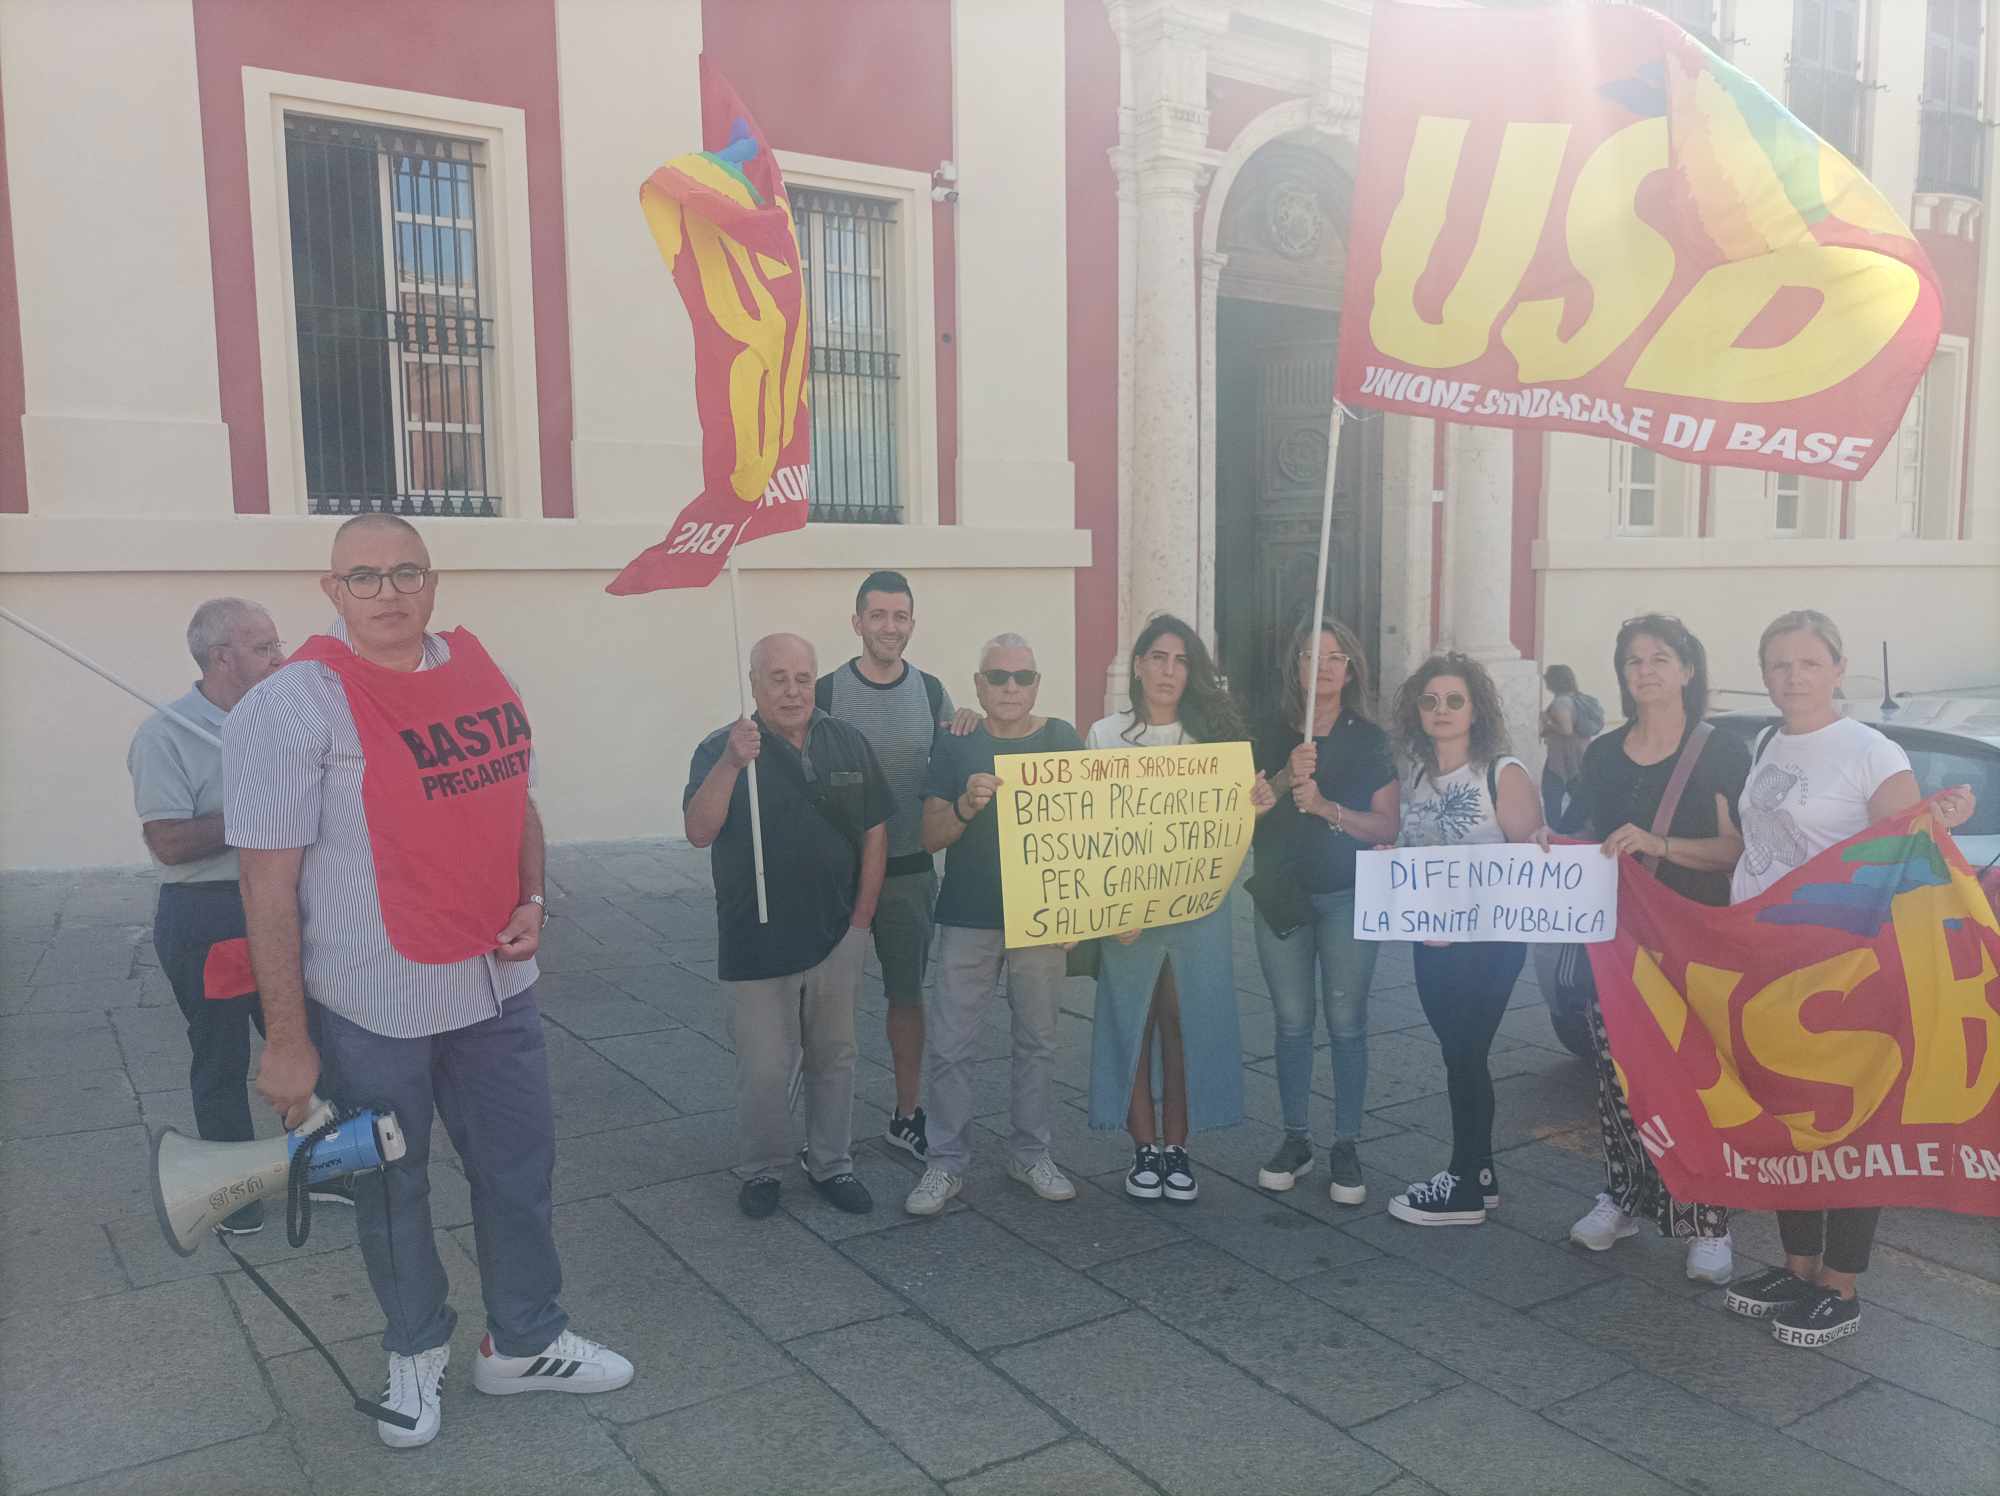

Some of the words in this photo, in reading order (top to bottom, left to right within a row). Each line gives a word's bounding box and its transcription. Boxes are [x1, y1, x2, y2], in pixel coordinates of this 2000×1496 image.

[1360, 366, 1481, 414] UNIONE
[1662, 412, 1717, 452] DI
[1726, 421, 1873, 471] BASE
[398, 701, 532, 769] BASTA
[1021, 758, 1073, 786] USB
[1135, 755, 1219, 778] SARDEGNA
[1014, 789, 1094, 825] BASTA
[1110, 781, 1242, 819] PRECARIETÀ
[1023, 822, 1153, 864] ASSUNZIONI
[1163, 817, 1244, 854] STABILI
[1041, 868, 1090, 904] PER
[1103, 856, 1224, 897] GARANTIRE
[1389, 857, 1583, 891] DIFENDIAMO
[1025, 902, 1134, 938] SALUTE
[1143, 899, 1161, 924] E
[1168, 889, 1223, 919] CURE
[1361, 911, 1390, 933] LA
[1400, 903, 1480, 933] SANITÀ
[1492, 904, 1605, 934] PUBBLICA
[1959, 1144, 2000, 1182] BA
